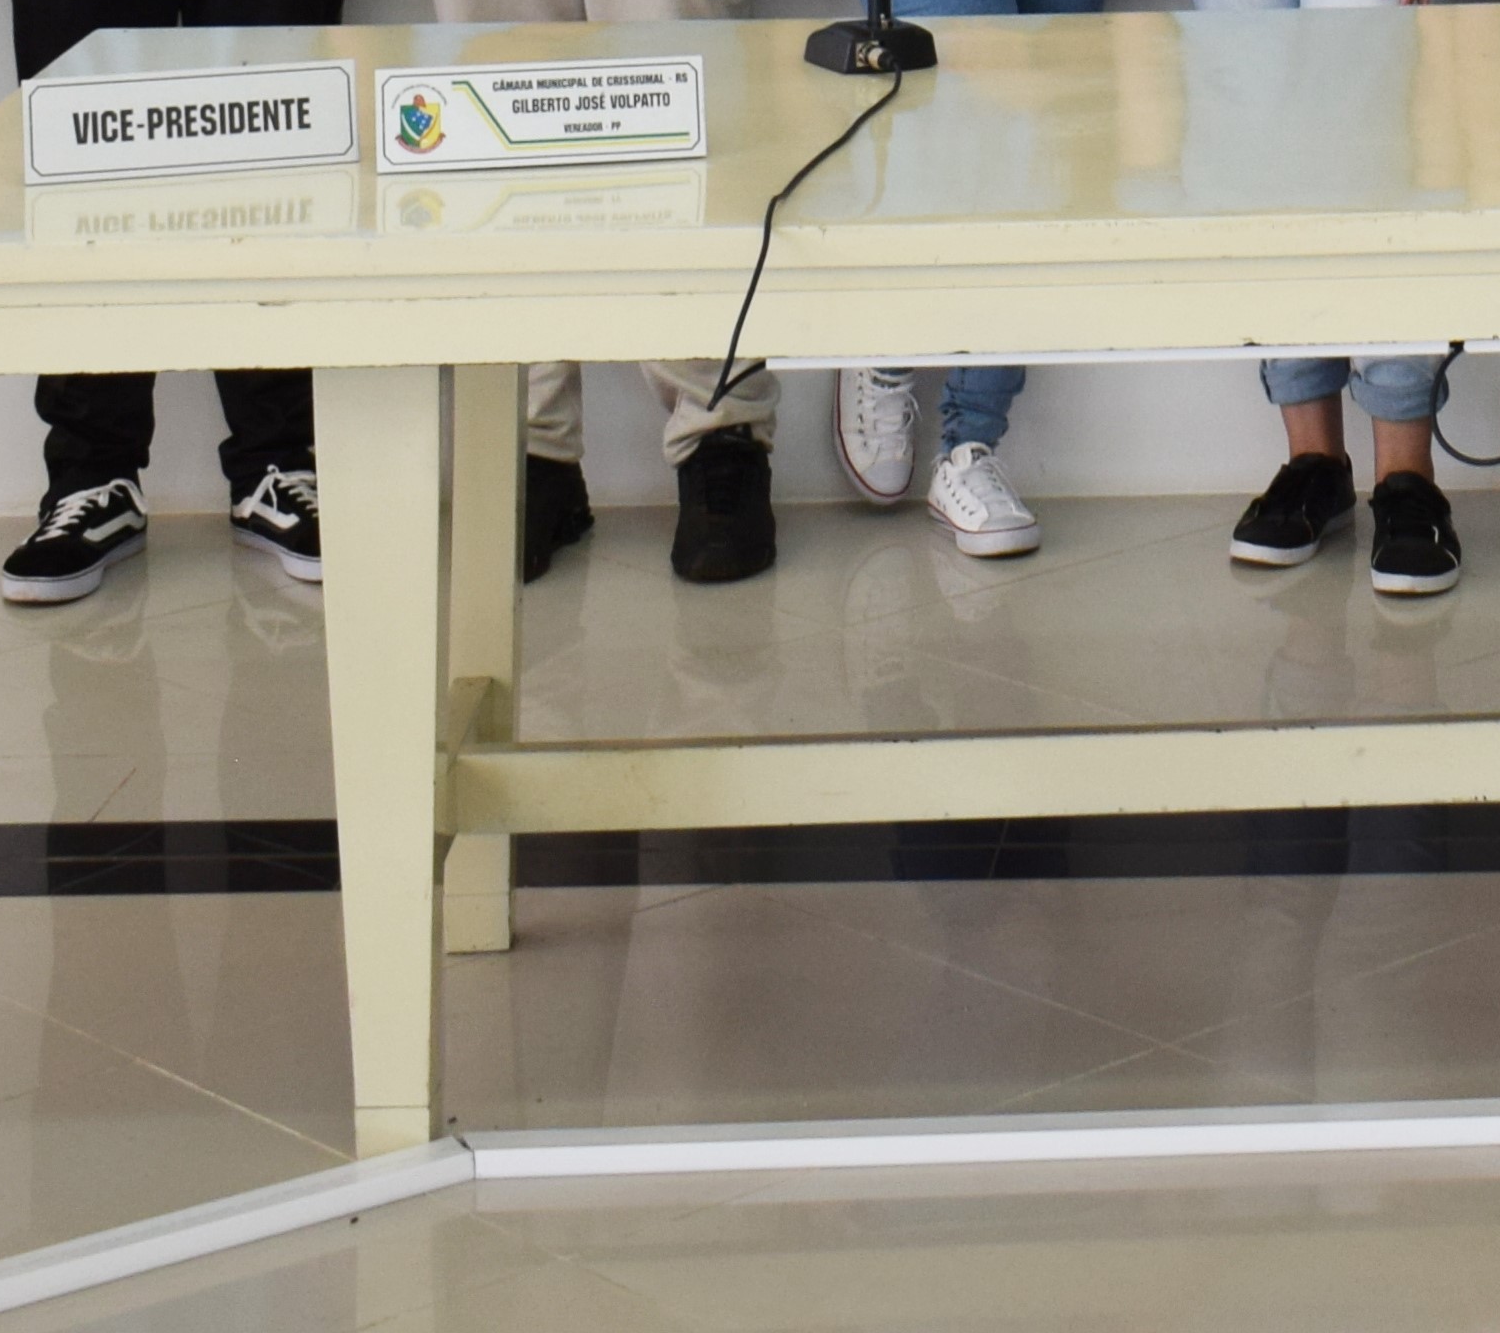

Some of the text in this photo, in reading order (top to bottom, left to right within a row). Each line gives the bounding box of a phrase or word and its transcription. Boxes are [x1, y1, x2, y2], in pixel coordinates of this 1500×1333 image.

[493, 78, 533, 92] CÂMARA
[536, 76, 588, 90] MUNICIPAL
[592, 75, 603, 88] DE
[607, 73, 664, 87] CRISSIUMAL
[675, 72, 688, 83] RS
[512, 91, 671, 114] GILBERTO JOSÉ VOLPATTO
[72, 97, 311, 145] VICE-PRESIDENTE
